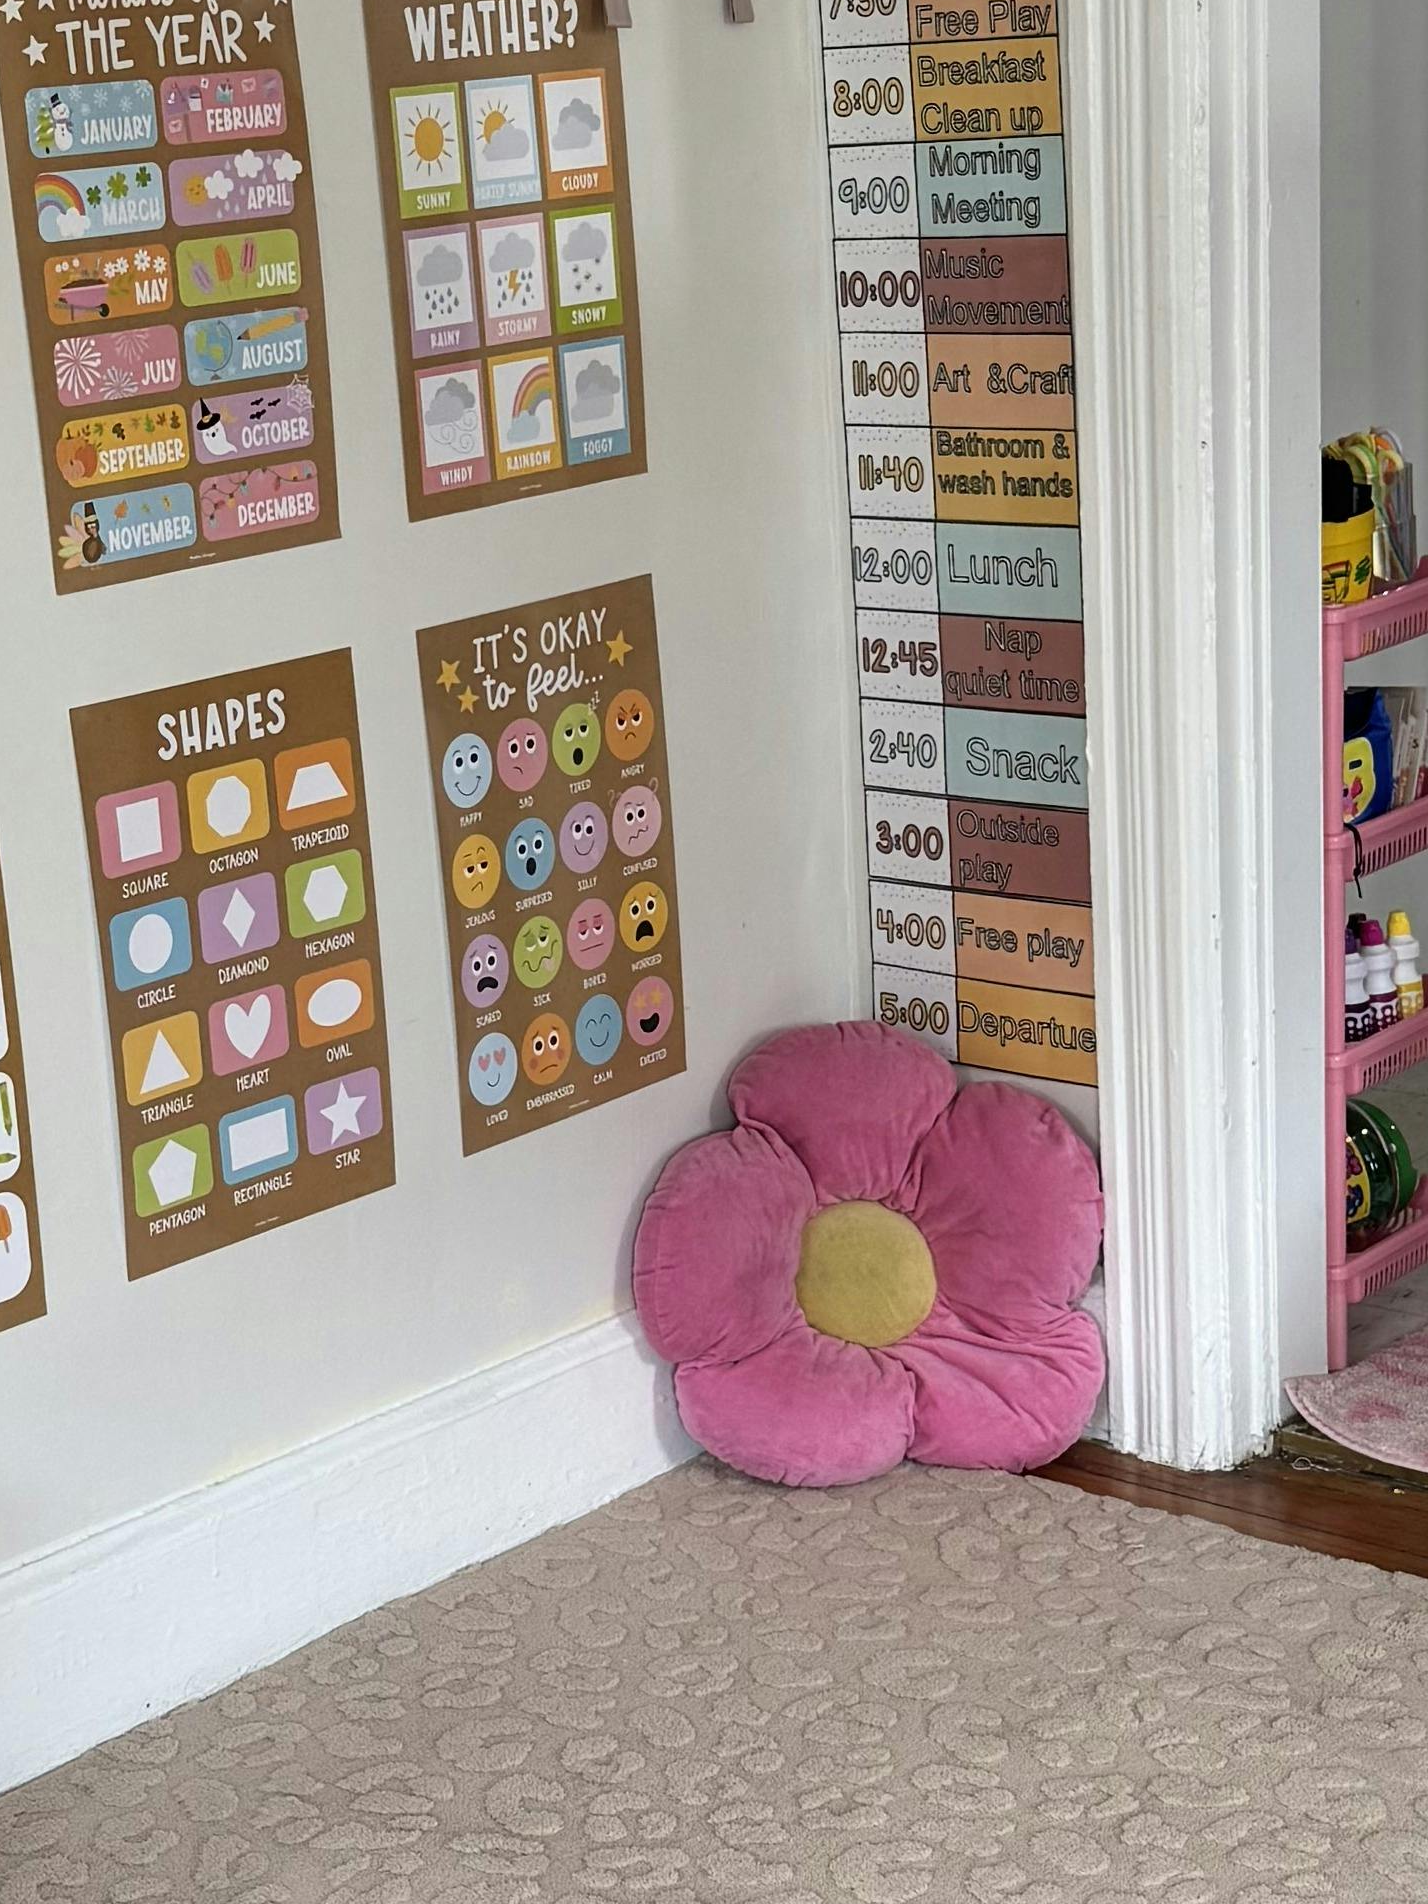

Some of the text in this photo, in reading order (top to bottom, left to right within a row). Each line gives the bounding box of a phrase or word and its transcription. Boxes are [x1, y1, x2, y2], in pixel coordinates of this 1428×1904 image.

[916, 0, 1051, 38] Free Play
[55, 9, 247, 75] THE YEAR
[918, 51, 1045, 87] Breakfast
[833, 78, 904, 117] 8:00
[80, 112, 152, 146] JANUARY
[206, 103, 282, 133] FEBRUARY
[922, 104, 1043, 136] Clean up
[930, 146, 1041, 180] Morning
[247, 182, 291, 210] APRIL
[562, 173, 598, 192] CLOUDY
[838, 177, 910, 214] 9:00
[416, 191, 451, 210] SUNNY
[932, 193, 1041, 228] Meeting
[256, 264, 297, 290] JUNE
[925, 251, 1004, 281] Music
[136, 279, 168, 305] MAY
[840, 272, 920, 306] 10:00
[498, 318, 537, 336] STORMY
[572, 306, 606, 326] SNOWY
[242, 336, 302, 369] AUGUST
[141, 358, 176, 386] JULY
[242, 417, 309, 449] OCTOBER
[98, 438, 185, 475] SEPTEMBER
[237, 492, 316, 528] DECEMBER
[853, 547, 933, 584] 12:00
[947, 544, 1058, 588] Lunch
[473, 607, 608, 675] IT'S OKAY
[482, 674, 516, 712] to
[157, 688, 287, 761] SHAPES
[869, 729, 937, 769] 2:40
[966, 737, 1081, 784] Snack
[291, 824, 350, 852] TRAPEZOID
[209, 849, 259, 875] OCTAGON
[122, 873, 170, 898] SQUARE
[956, 917, 1084, 968] Free play
[218, 958, 269, 984] DIAMOND
[137, 985, 176, 1009] CIRCLE
[880, 993, 949, 1035] 5:00
[958, 1002, 1097, 1054] Departue
